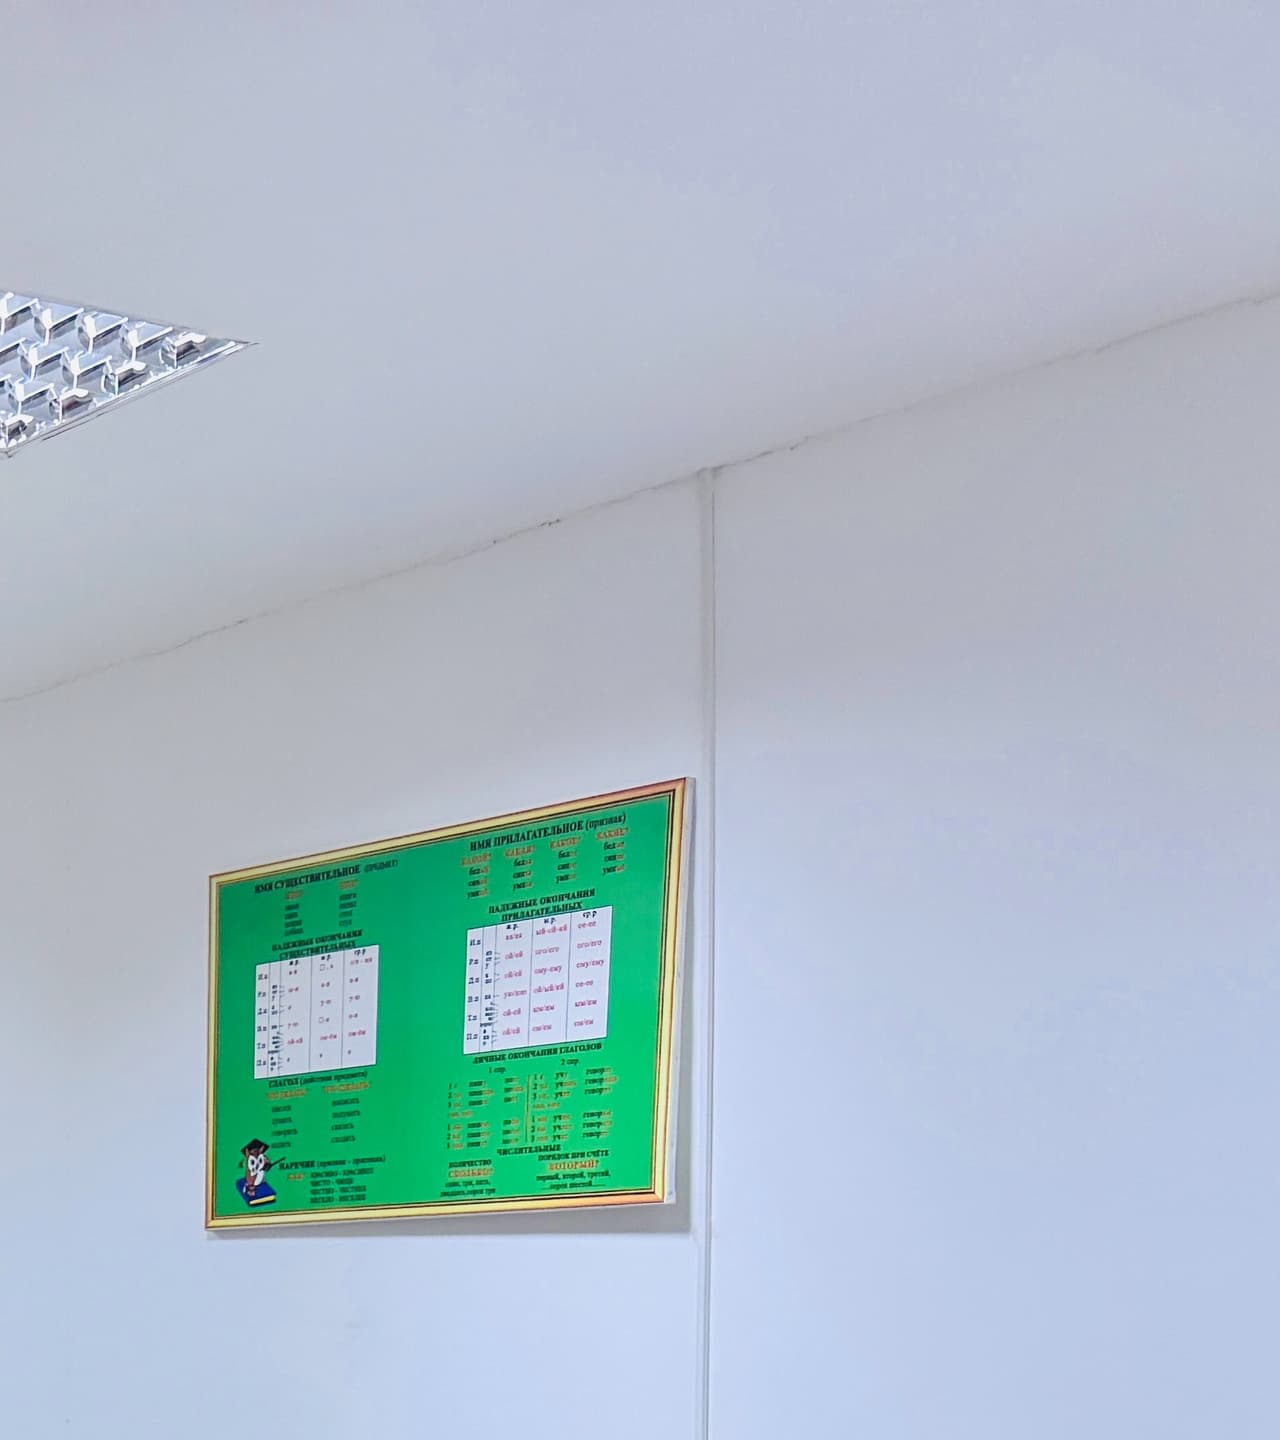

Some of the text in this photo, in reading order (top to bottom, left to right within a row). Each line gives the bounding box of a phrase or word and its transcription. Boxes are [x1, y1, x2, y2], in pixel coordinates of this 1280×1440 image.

[470, 839, 490, 851] ИМЯ
[494, 821, 583, 846] ПРИЛАГАТЕЛЬНОЕ
[274, 865, 360, 889] СУЩЕСТВИТЕЛЬНОЕ
[489, 888, 595, 914] ПАДЕЖНЫЕ ОКОНЧАНИЯ
[501, 901, 583, 922] ПРИЛАГАТЕЛЬНЫХ
[559, 1043, 602, 1054] ГЛАГОЛОВ
